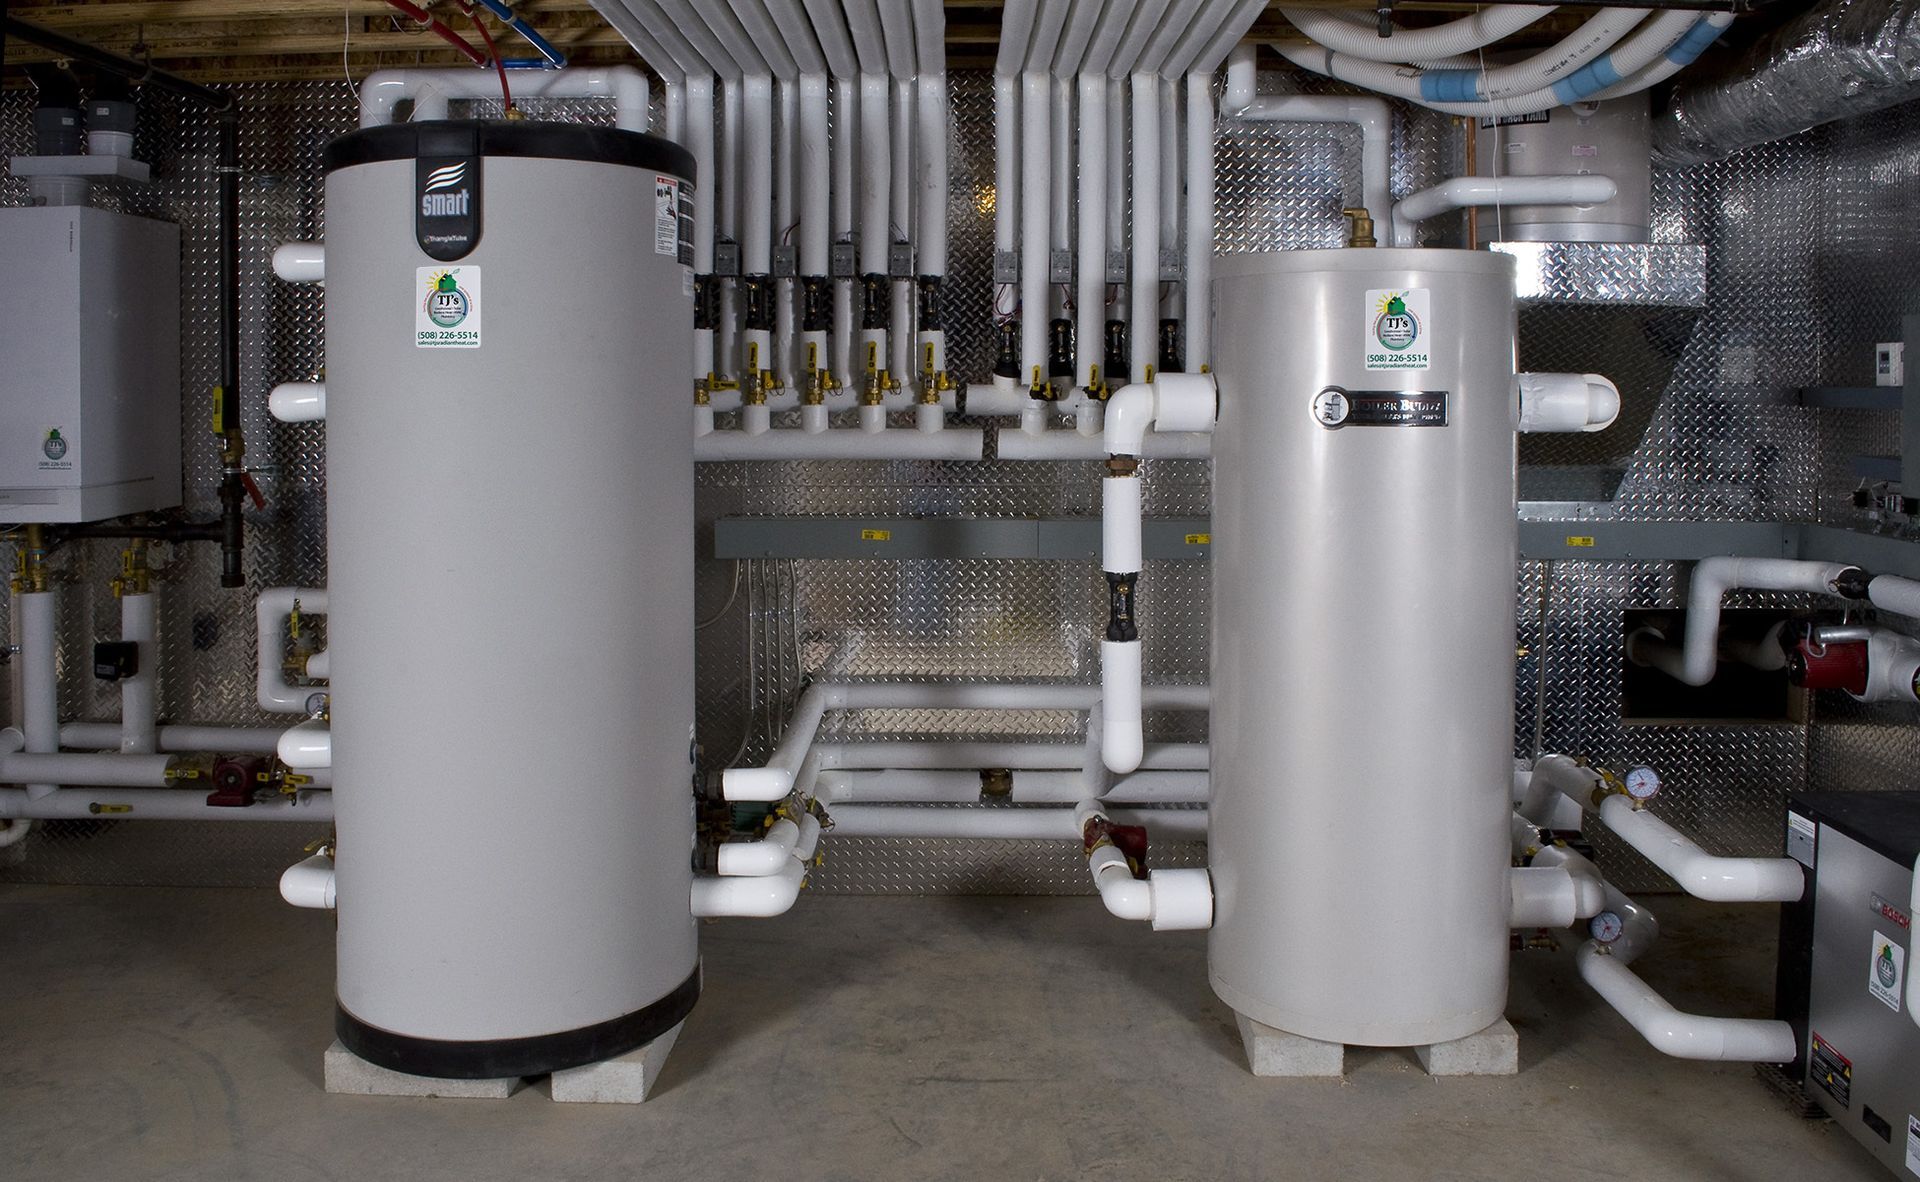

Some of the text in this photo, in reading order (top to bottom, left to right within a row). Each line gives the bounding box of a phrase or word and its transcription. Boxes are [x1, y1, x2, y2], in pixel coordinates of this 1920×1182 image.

[422, 189, 469, 216] smart
[437, 295, 460, 307] TJ's
[1387, 318, 1409, 329] TJ's
[418, 331, 478, 339] (508) 226-5514
[1367, 354, 1428, 362] (508) 226-5514
[1882, 904, 1910, 929] BOSCH
